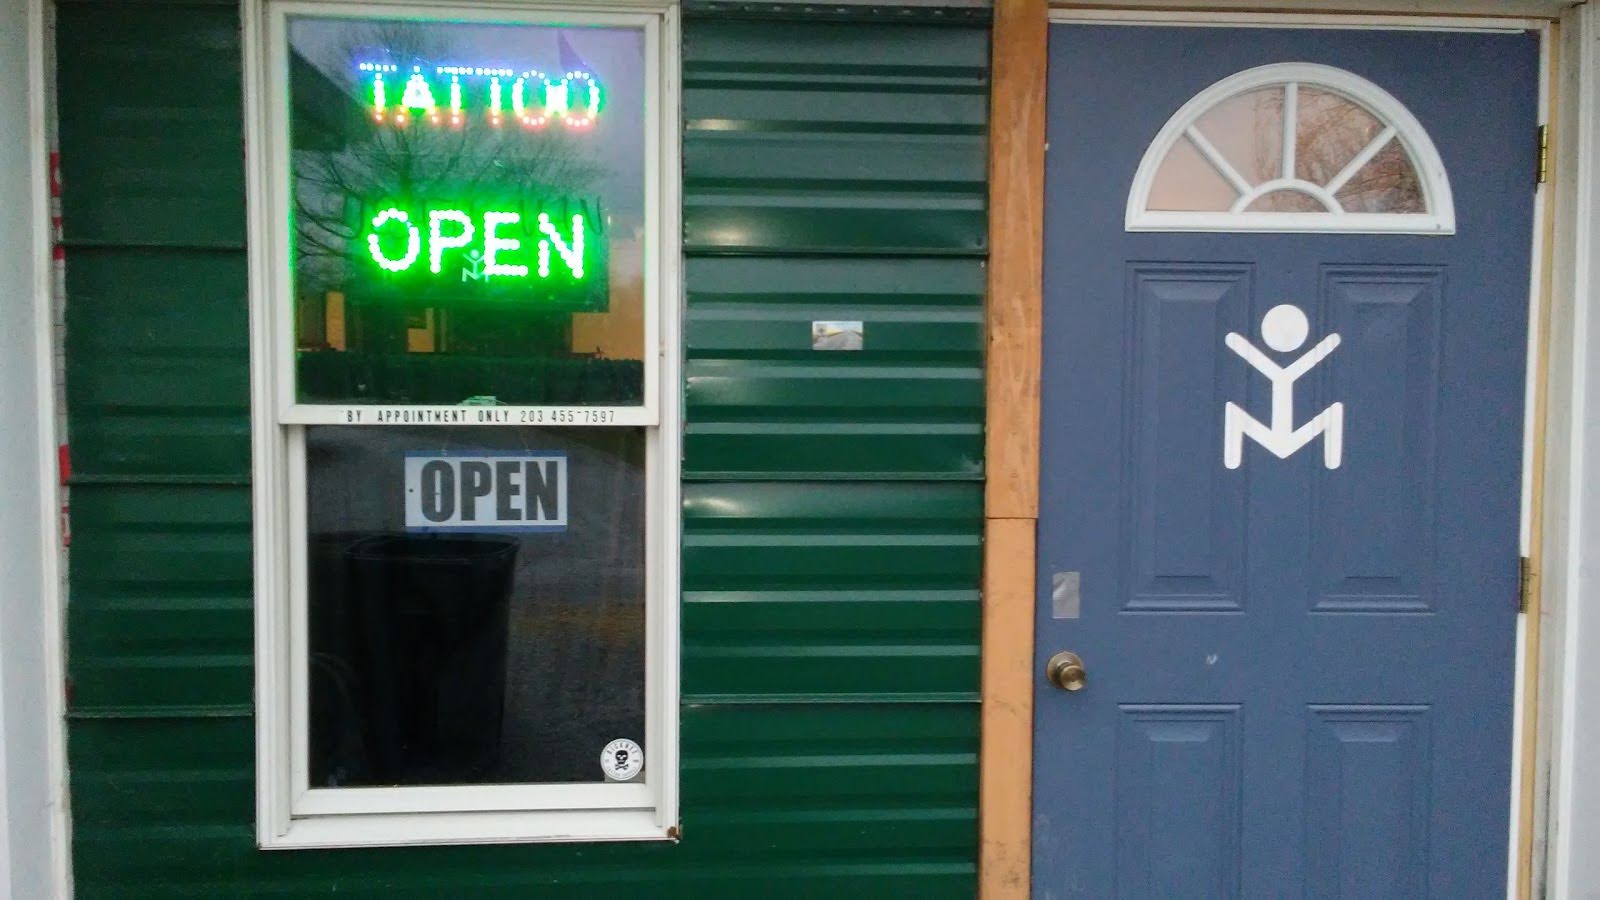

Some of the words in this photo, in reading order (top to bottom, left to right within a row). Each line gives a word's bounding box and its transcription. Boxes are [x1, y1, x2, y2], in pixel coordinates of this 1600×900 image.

[359, 62, 601, 127] TATTOO
[367, 207, 585, 279] OPEN
[346, 409, 362, 422] BY
[377, 409, 467, 423] APPOINTMENT
[478, 409, 510, 422] ONLY
[520, 409, 544, 423] 203
[421, 459, 559, 523] OPEN
